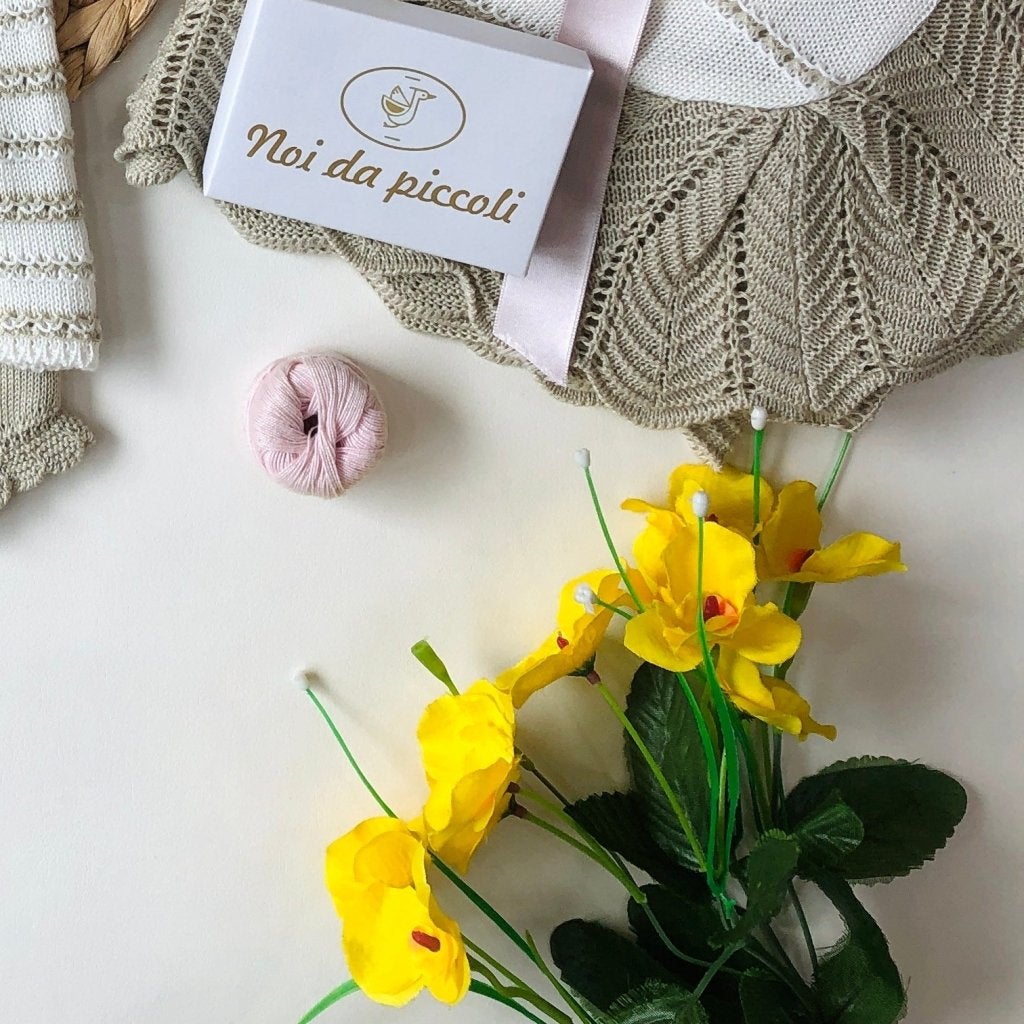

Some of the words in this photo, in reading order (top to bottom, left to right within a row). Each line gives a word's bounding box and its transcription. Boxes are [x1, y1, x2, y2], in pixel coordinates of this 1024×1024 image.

[246, 123, 325, 173] Noi
[320, 148, 383, 190] da
[382, 168, 527, 225] piccoli
